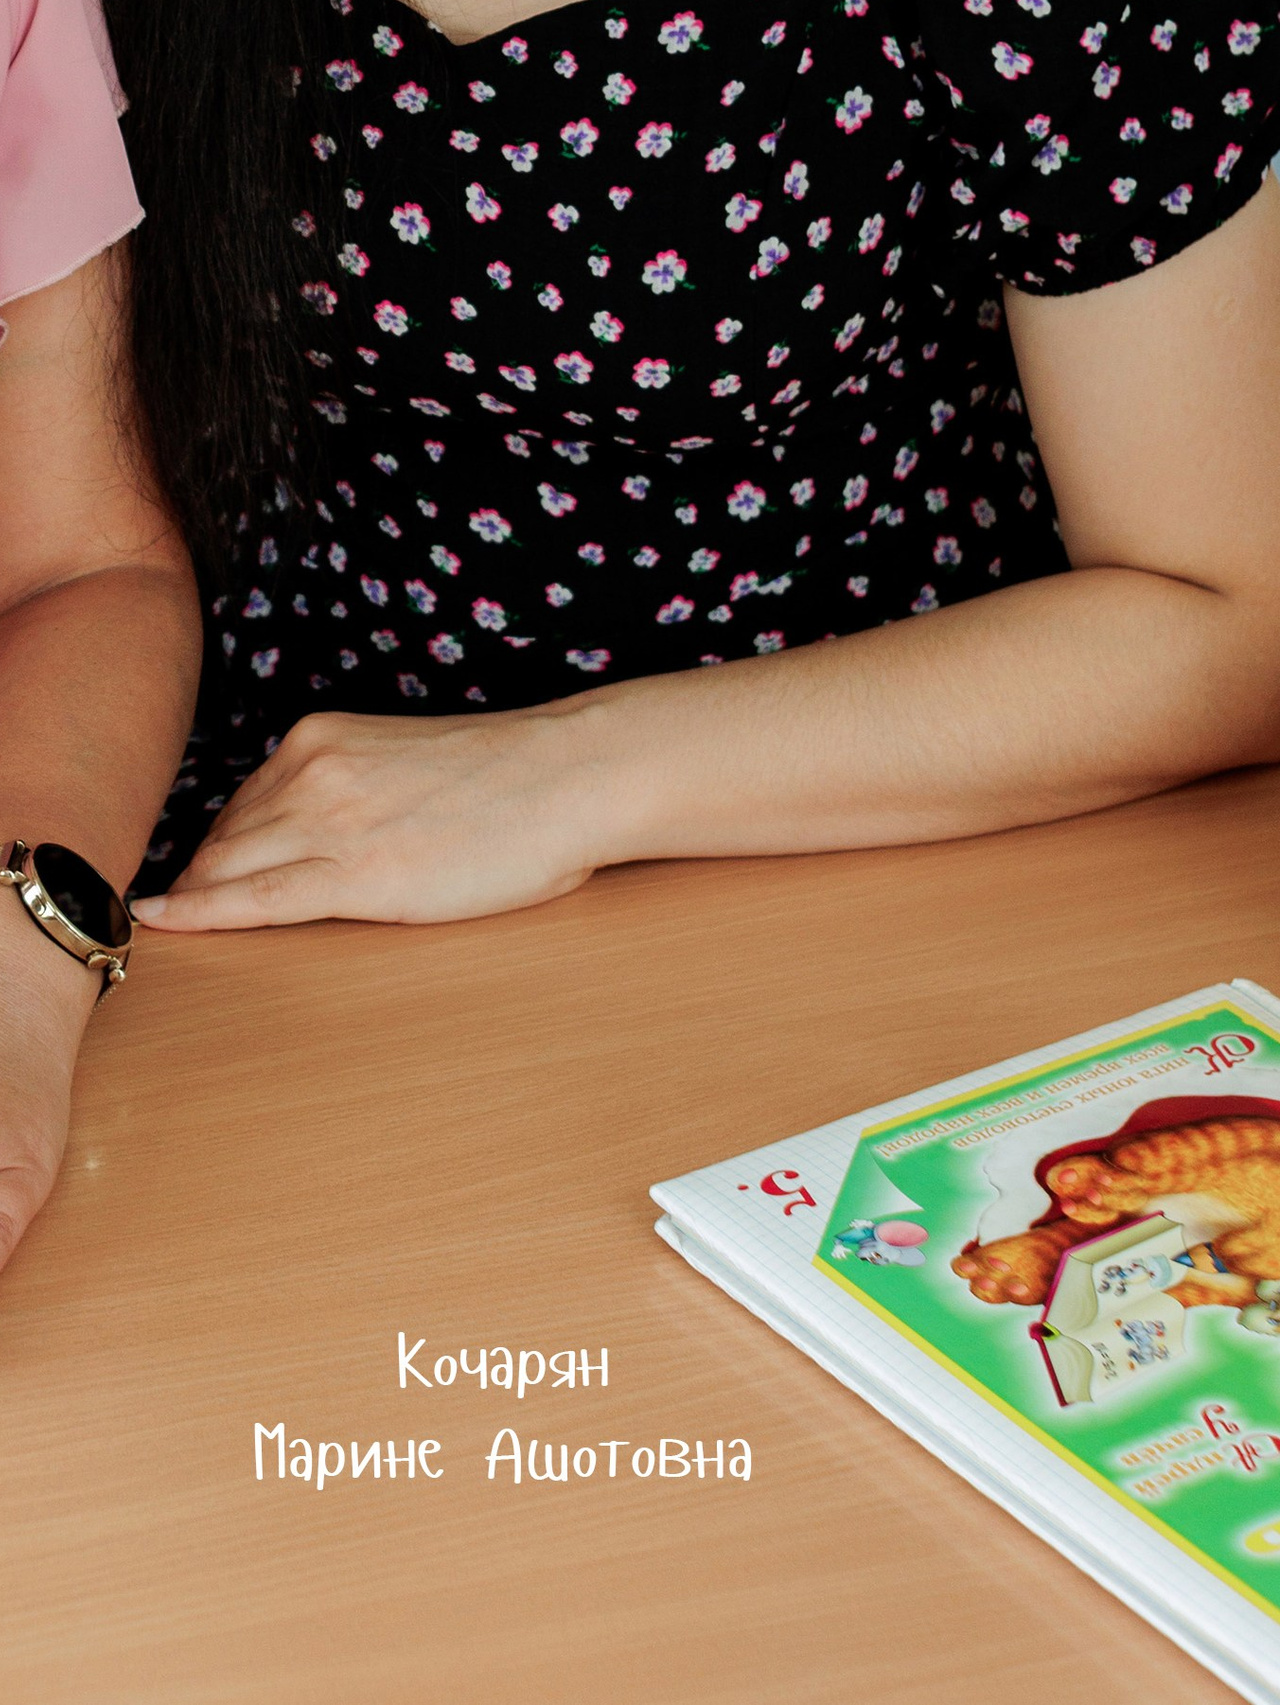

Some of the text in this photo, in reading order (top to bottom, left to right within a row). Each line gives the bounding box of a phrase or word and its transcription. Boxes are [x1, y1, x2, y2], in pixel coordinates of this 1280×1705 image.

[1122, 1043, 1169, 1066] всех
[1048, 1059, 1122, 1095] времен
[1074, 1076, 1139, 1104] юных
[1027, 1085, 1043, 1101] и
[979, 1095, 1024, 1121] всех
[952, 1097, 1074, 1150] счетоводов
